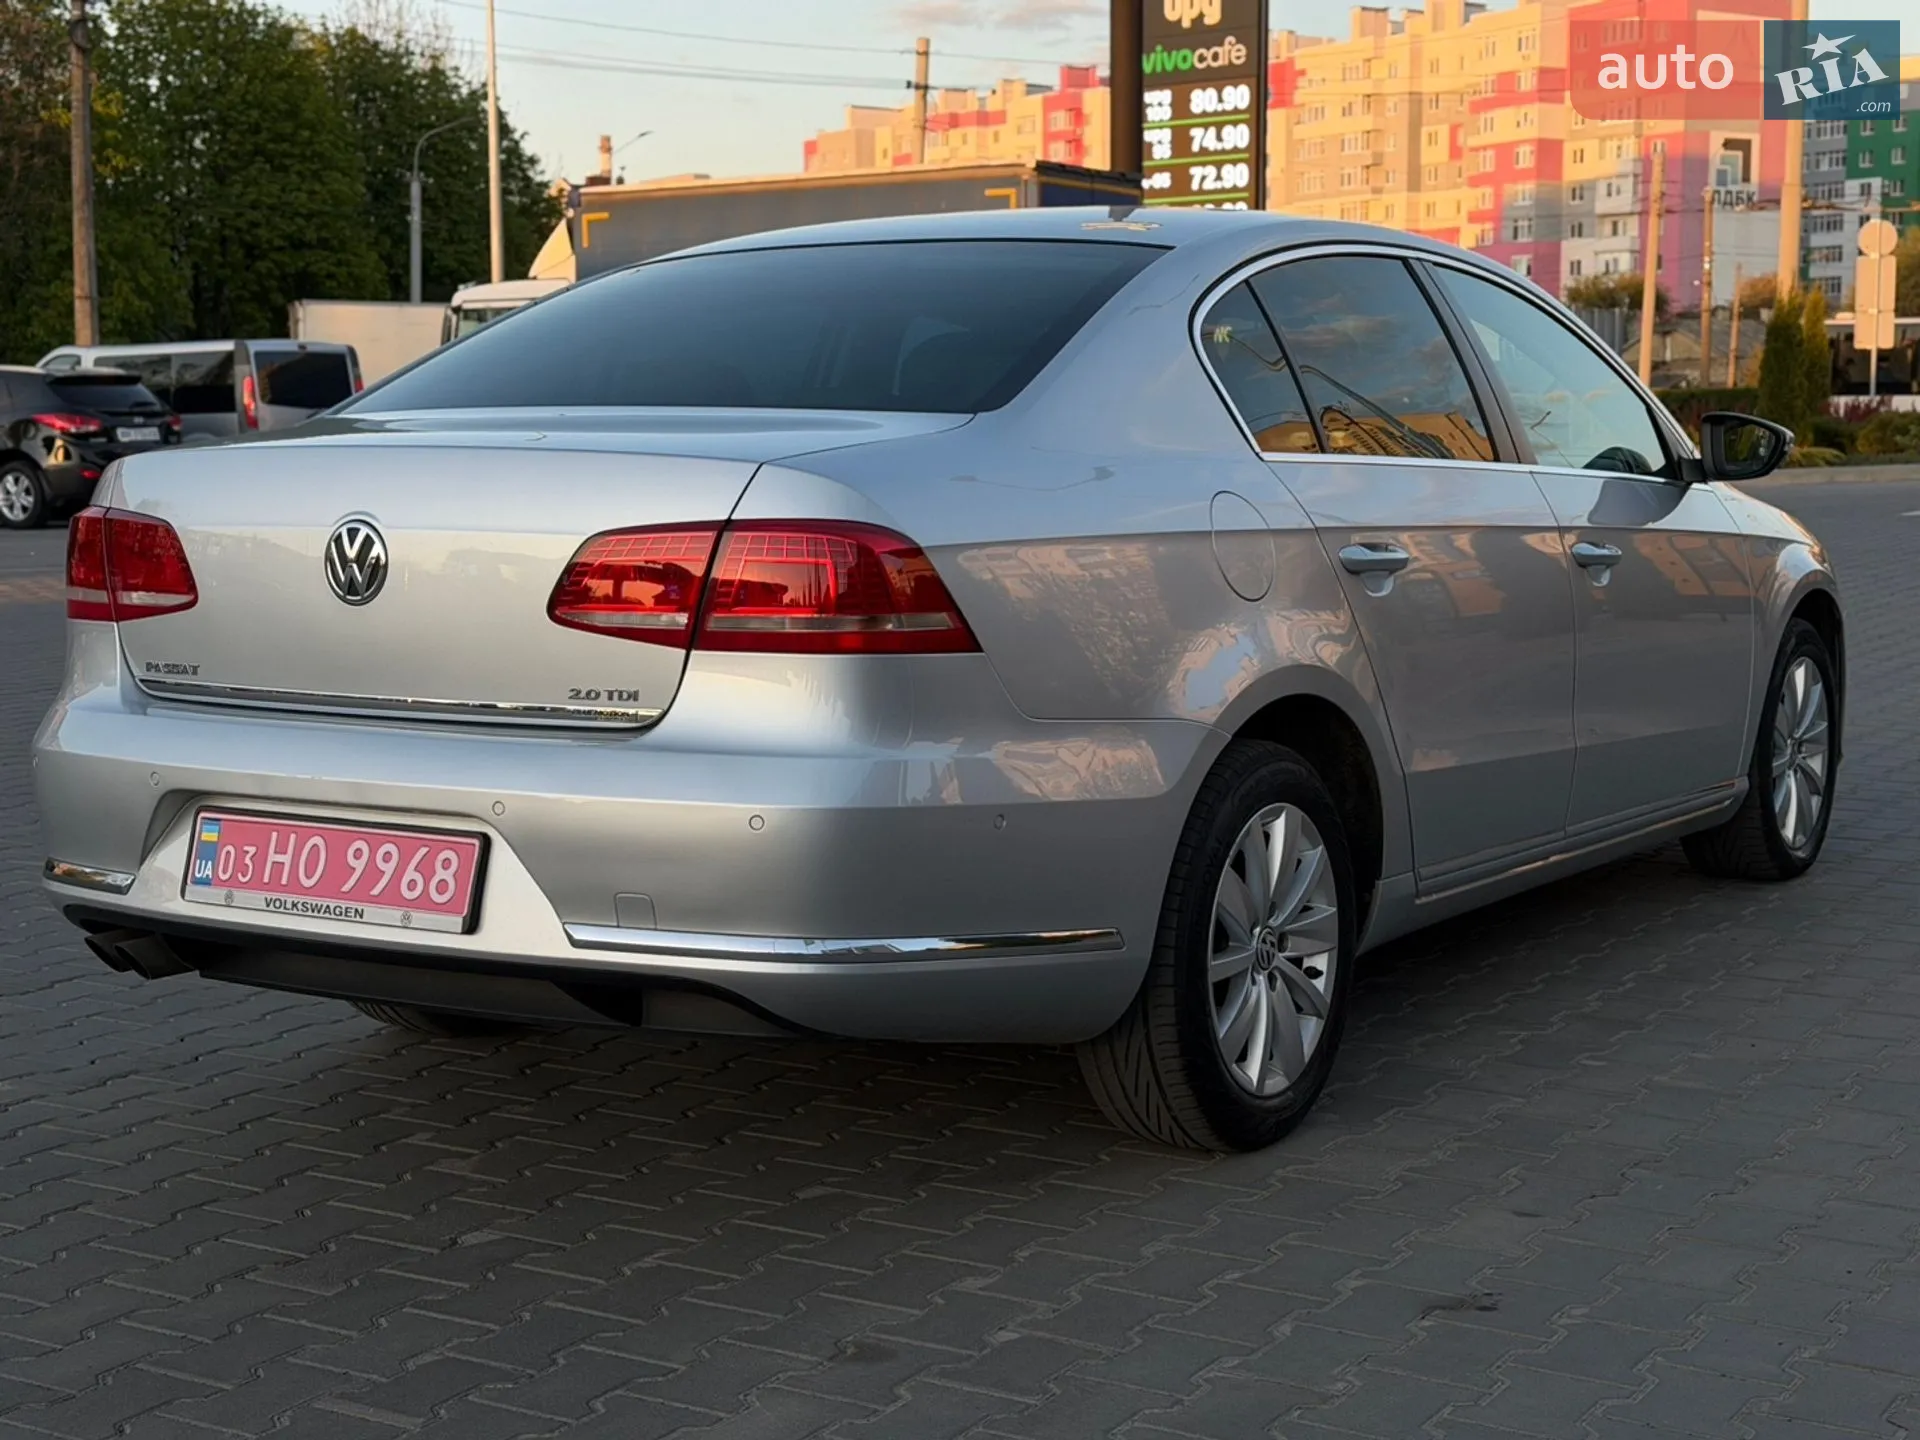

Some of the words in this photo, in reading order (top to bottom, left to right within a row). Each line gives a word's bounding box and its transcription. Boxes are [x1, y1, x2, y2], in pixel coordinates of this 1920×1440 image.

[1142, 36, 1247, 74] vivocafe
[1190, 84, 1250, 114] 80.90
[1189, 123, 1250, 153] 74.90
[1189, 162, 1249, 191] 72.90
[145, 661, 201, 677] PASSAT
[567, 687, 601, 701] 2.0
[602, 688, 640, 702] TDI
[194, 858, 213, 879] UA
[217, 843, 258, 883] 03
[339, 838, 460, 905] 9968
[264, 896, 364, 920] VOLKSWAGEN
